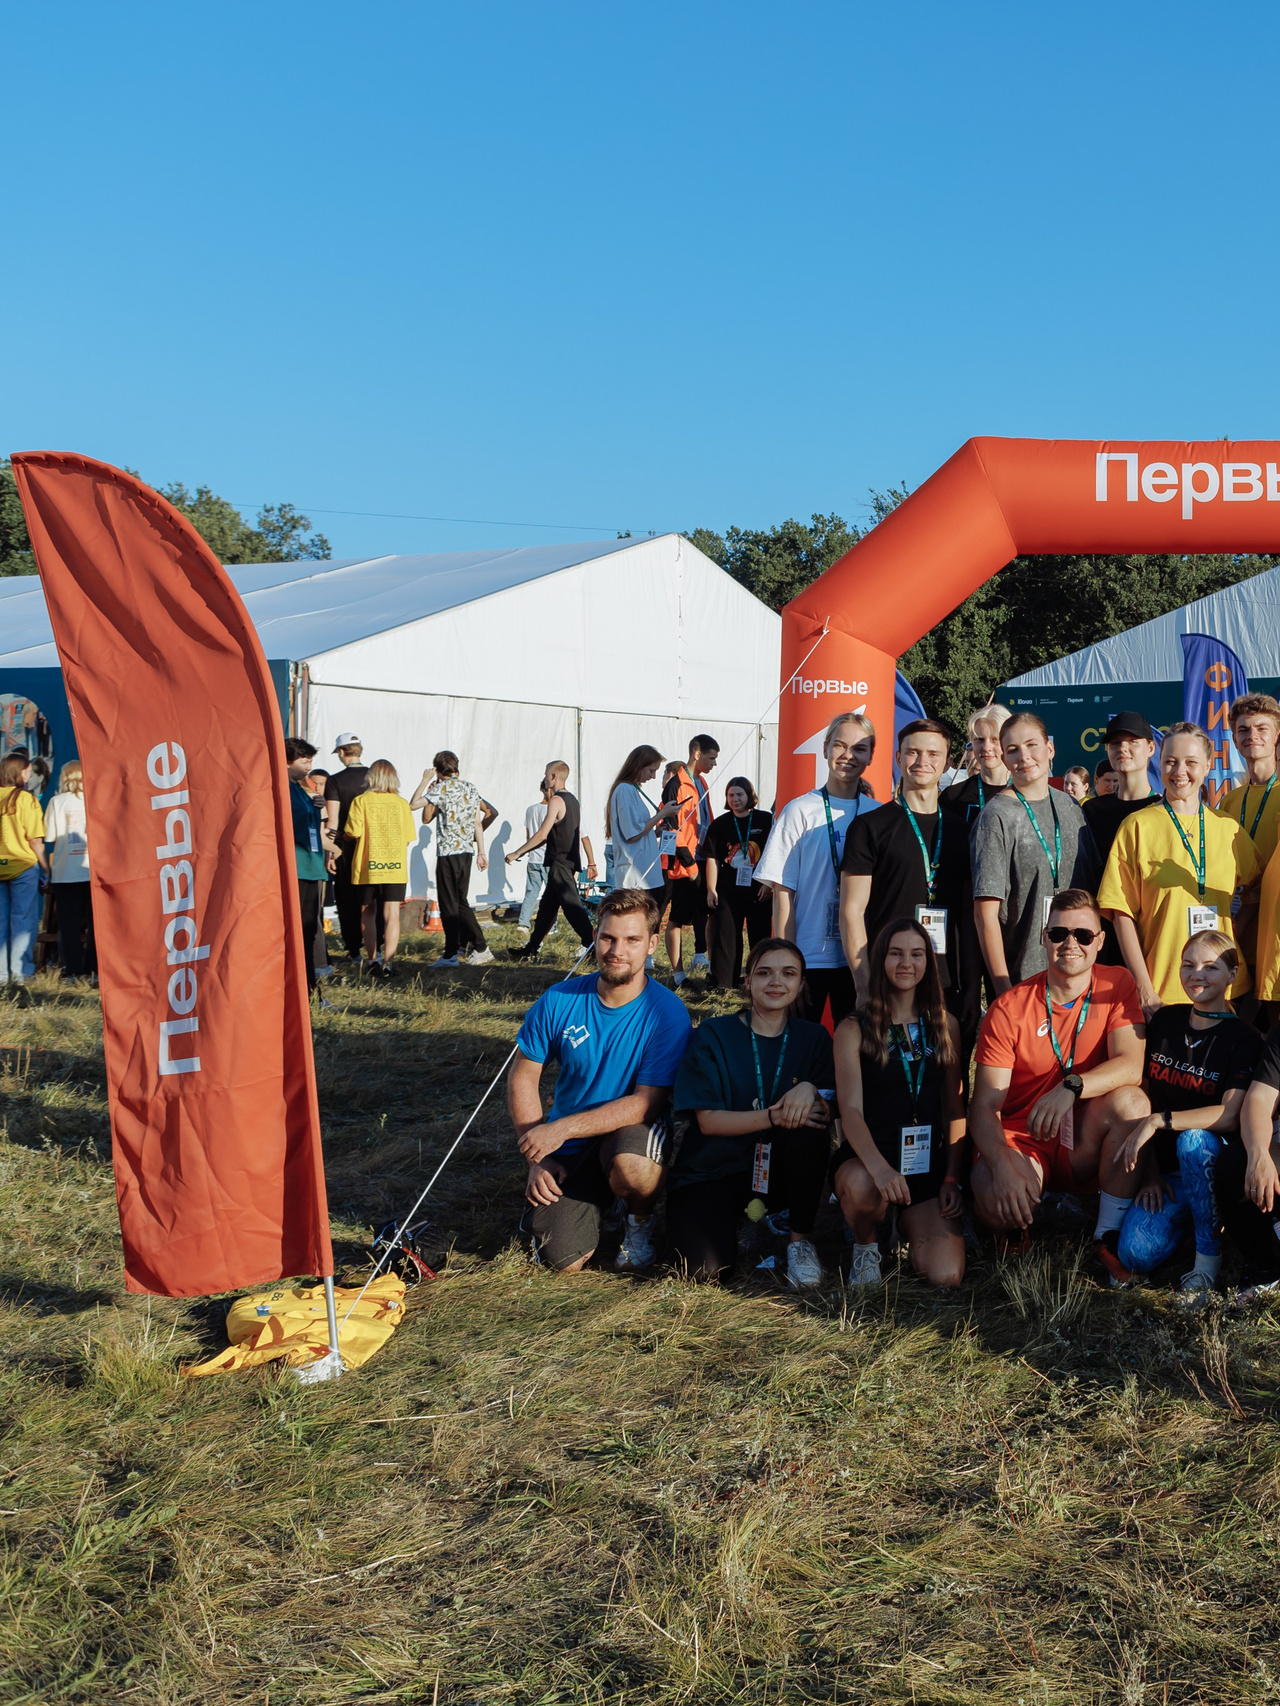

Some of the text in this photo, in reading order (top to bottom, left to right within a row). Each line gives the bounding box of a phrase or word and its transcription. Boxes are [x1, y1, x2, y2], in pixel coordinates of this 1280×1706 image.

[792, 676, 868, 698] Первые
[368, 860, 402, 870] Волга
[147, 741, 210, 1075] Первые
[1174, 1060, 1220, 1081] LEAGUE
